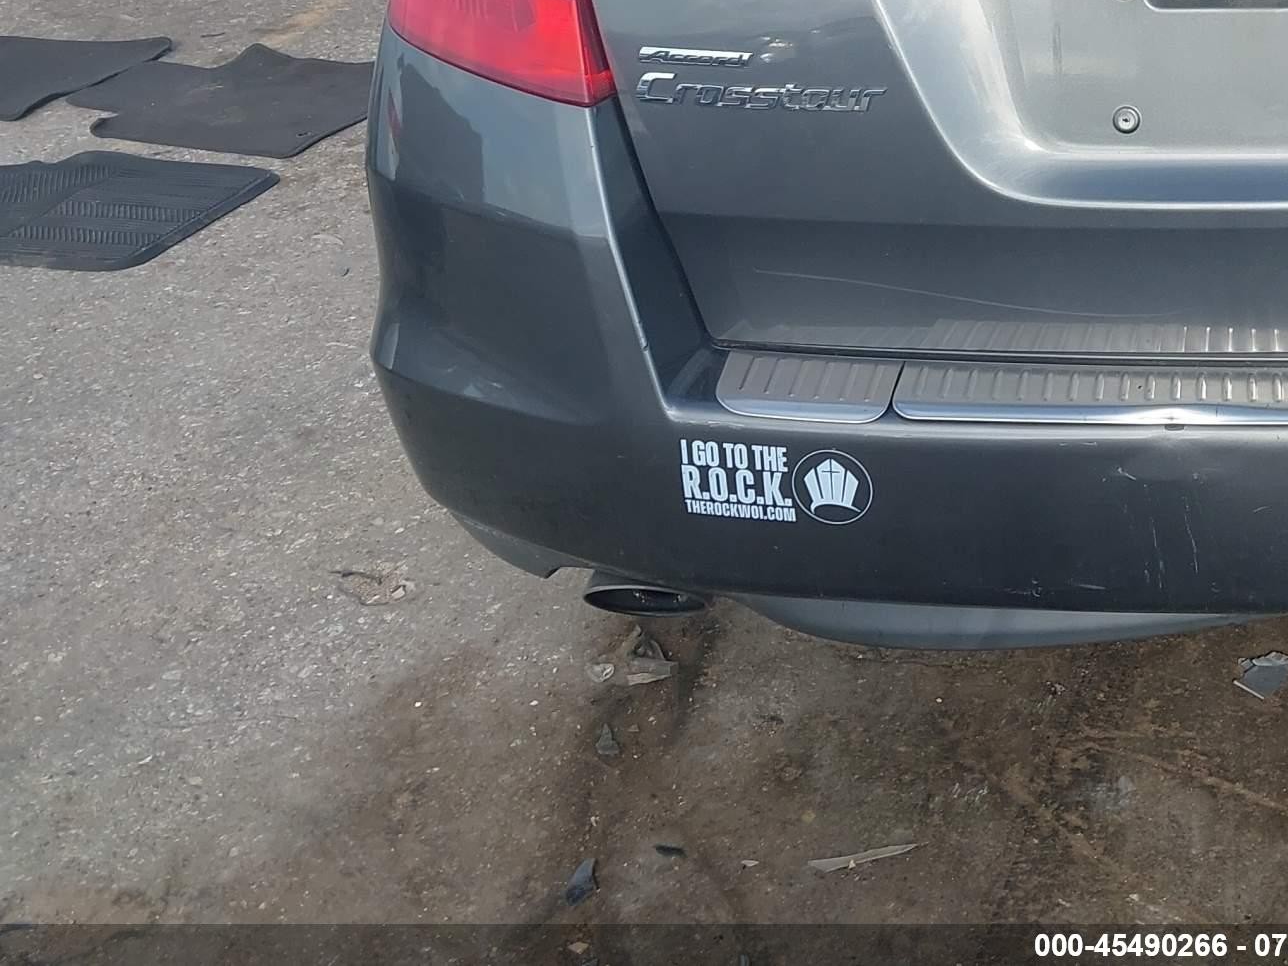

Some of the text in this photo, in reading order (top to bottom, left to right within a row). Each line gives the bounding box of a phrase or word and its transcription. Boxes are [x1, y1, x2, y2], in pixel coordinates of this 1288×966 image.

[640, 47, 753, 68] Accord
[636, 72, 887, 112] Crosstour
[680, 439, 789, 472] I GO TO THE
[680, 464, 793, 507] R.O.C.K.
[685, 499, 797, 522] THEROCKWOI.COM
